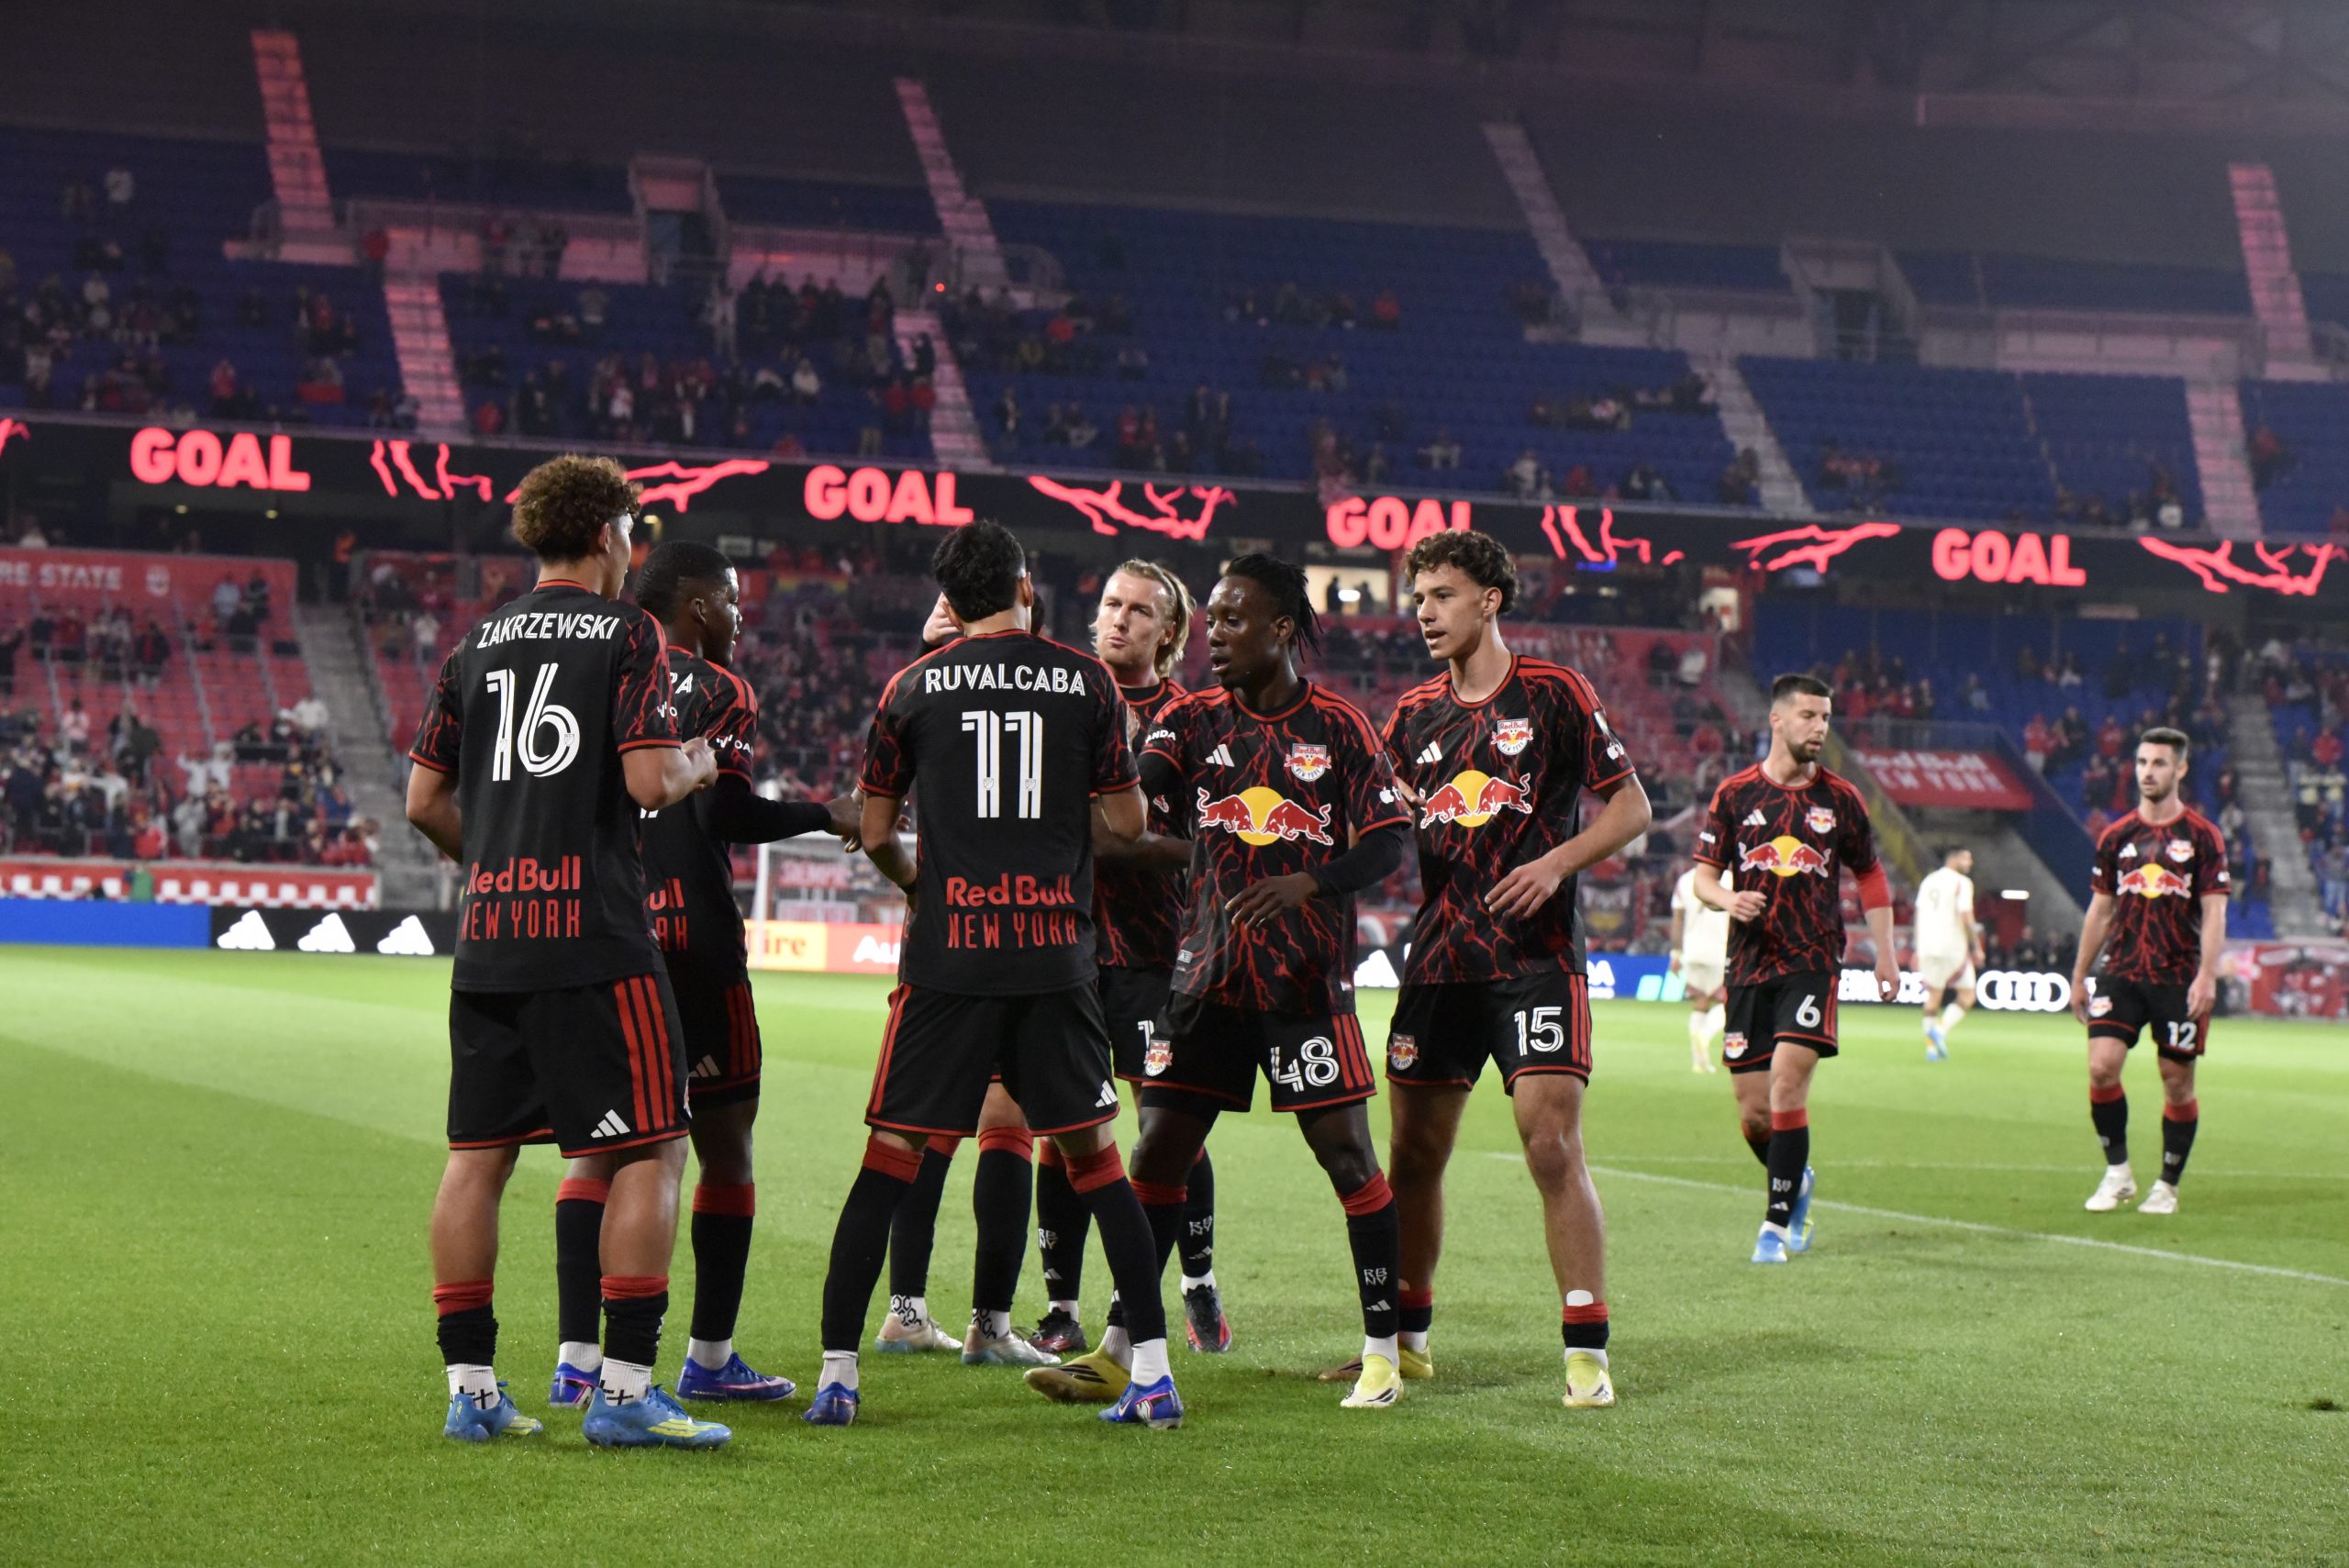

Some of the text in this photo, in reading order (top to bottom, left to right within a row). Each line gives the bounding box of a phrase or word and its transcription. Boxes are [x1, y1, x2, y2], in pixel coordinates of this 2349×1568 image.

[130, 427, 311, 492] GOAL
[804, 464, 974, 526] GOAL
[1932, 528, 2087, 586] GOAL
[40, 563, 123, 591] STATE
[476, 612, 620, 650] ZAKRZEWSKI
[925, 663, 1085, 696] RUVALCABA
[485, 662, 581, 782] 16
[962, 710, 1043, 819] 11
[466, 855, 581, 895] Red Bull
[649, 878, 685, 910] ull
[946, 873, 1075, 907] Red Bull
[511, 898, 581, 940] YORK
[947, 911, 1078, 949] NEW YORK
[1796, 994, 1821, 1029] 6
[1138, 1020, 1155, 1052] 1
[1514, 1006, 1564, 1057] 15
[2167, 1021, 2198, 1051] 12
[1270, 1036, 1340, 1093] 48
